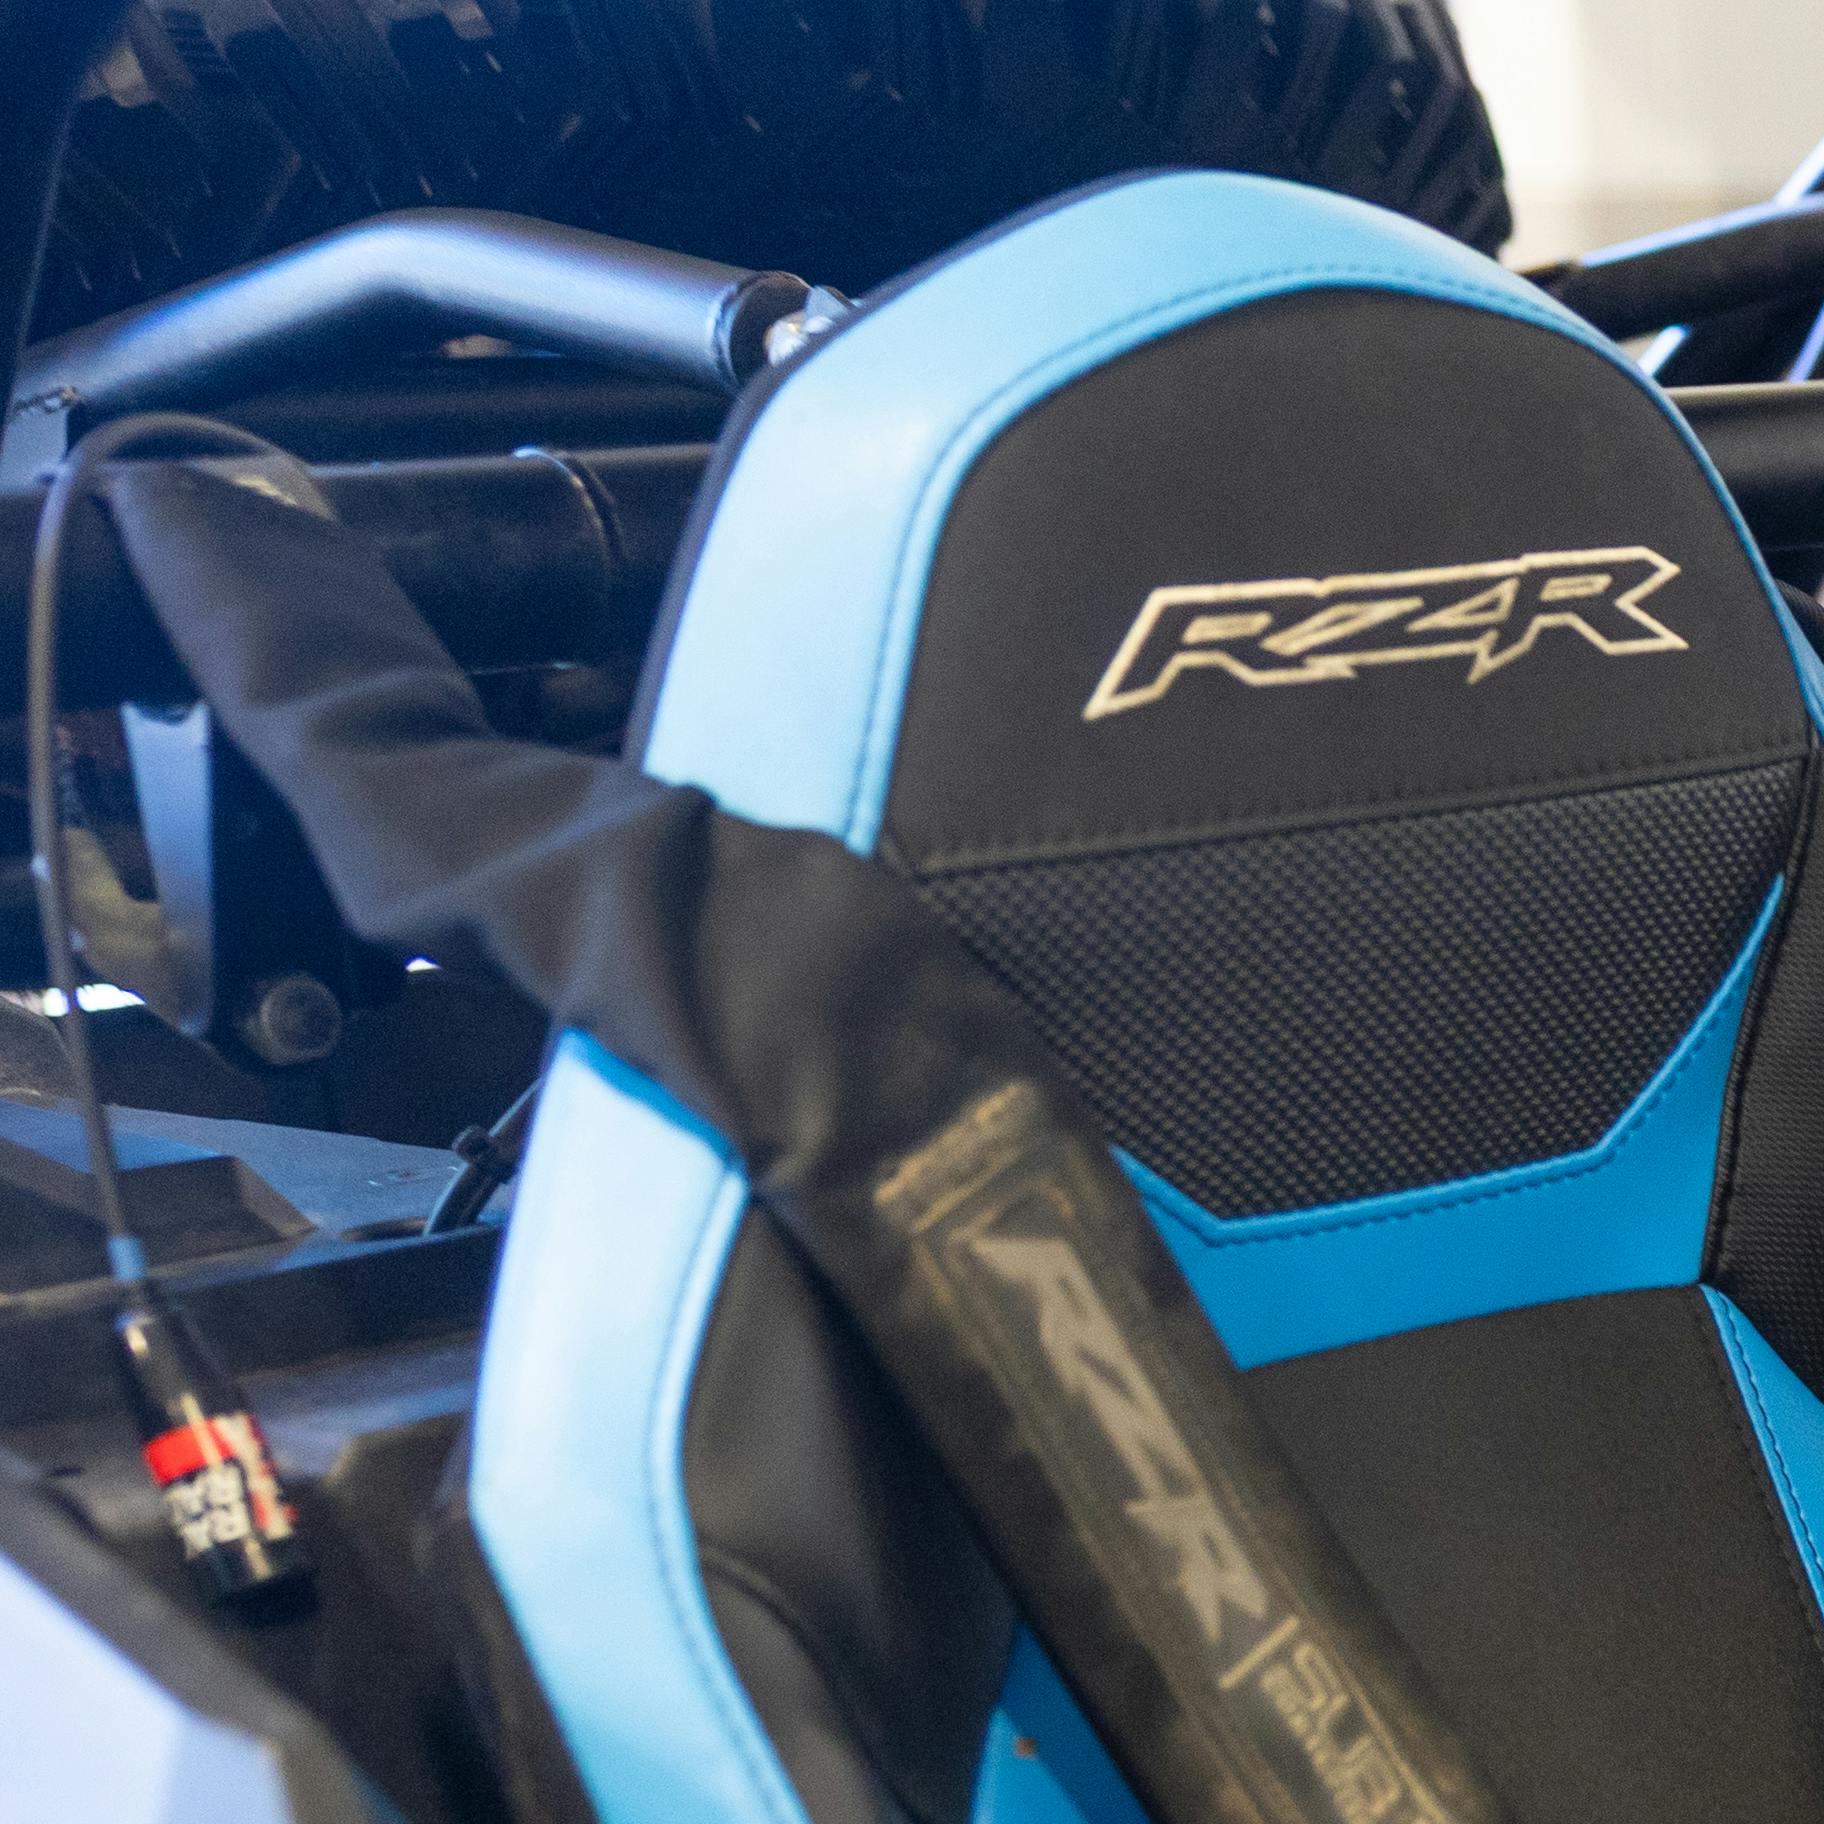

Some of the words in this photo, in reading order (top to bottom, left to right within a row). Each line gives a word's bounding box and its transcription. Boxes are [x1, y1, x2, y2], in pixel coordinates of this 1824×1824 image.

[1083, 546, 1690, 722] RZR
[968, 1236, 1269, 1645] RZR
[1294, 1642, 1401, 1816] SUB
